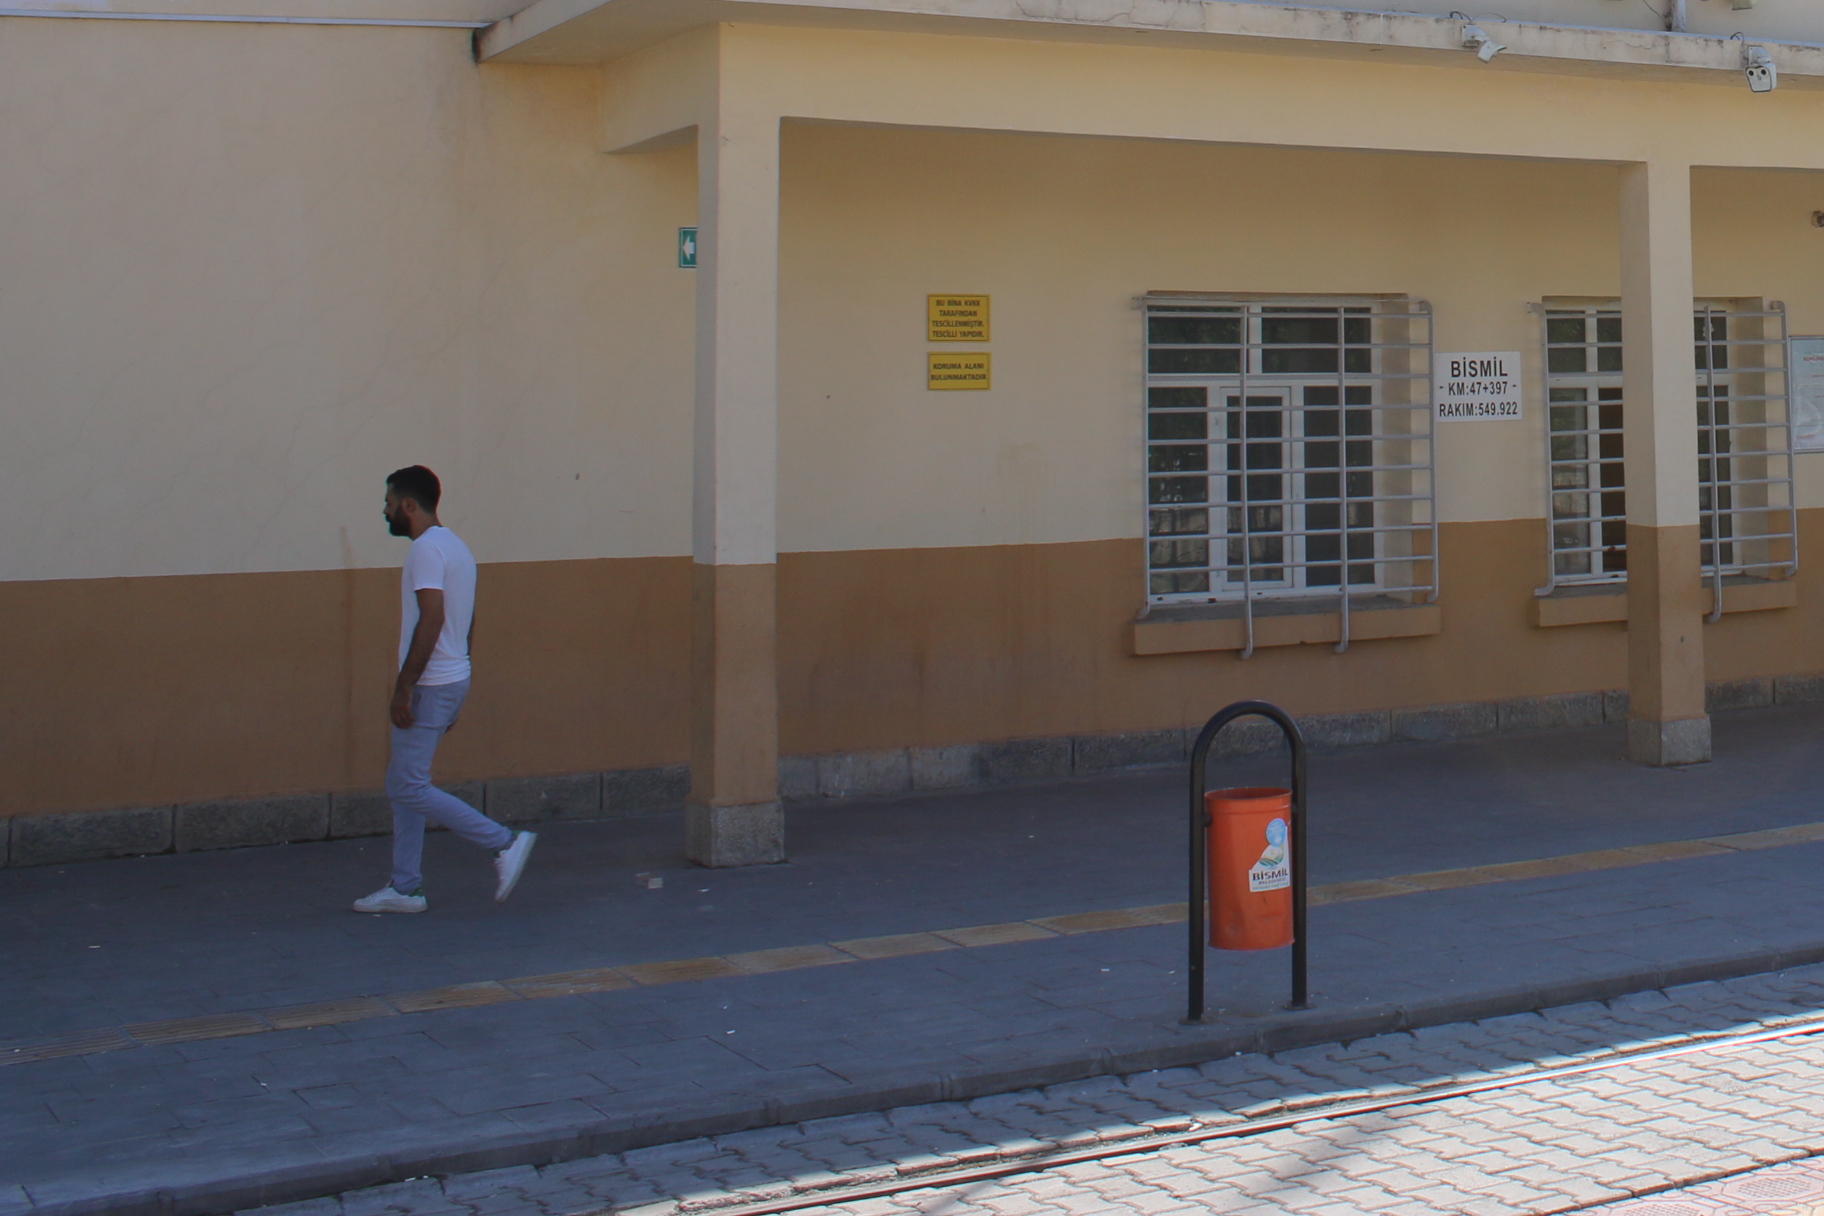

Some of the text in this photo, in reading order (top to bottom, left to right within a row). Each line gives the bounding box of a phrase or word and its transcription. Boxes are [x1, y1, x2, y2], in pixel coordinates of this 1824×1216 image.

[947, 298, 962, 306] BİNA
[932, 329, 957, 338] TESCİLLİ
[1451, 356, 1508, 378] BİSMİL
[1448, 381, 1508, 396] KM:47+397
[1439, 401, 1518, 417] RAKIM:549.922
[1253, 867, 1288, 881] BİSMİL
